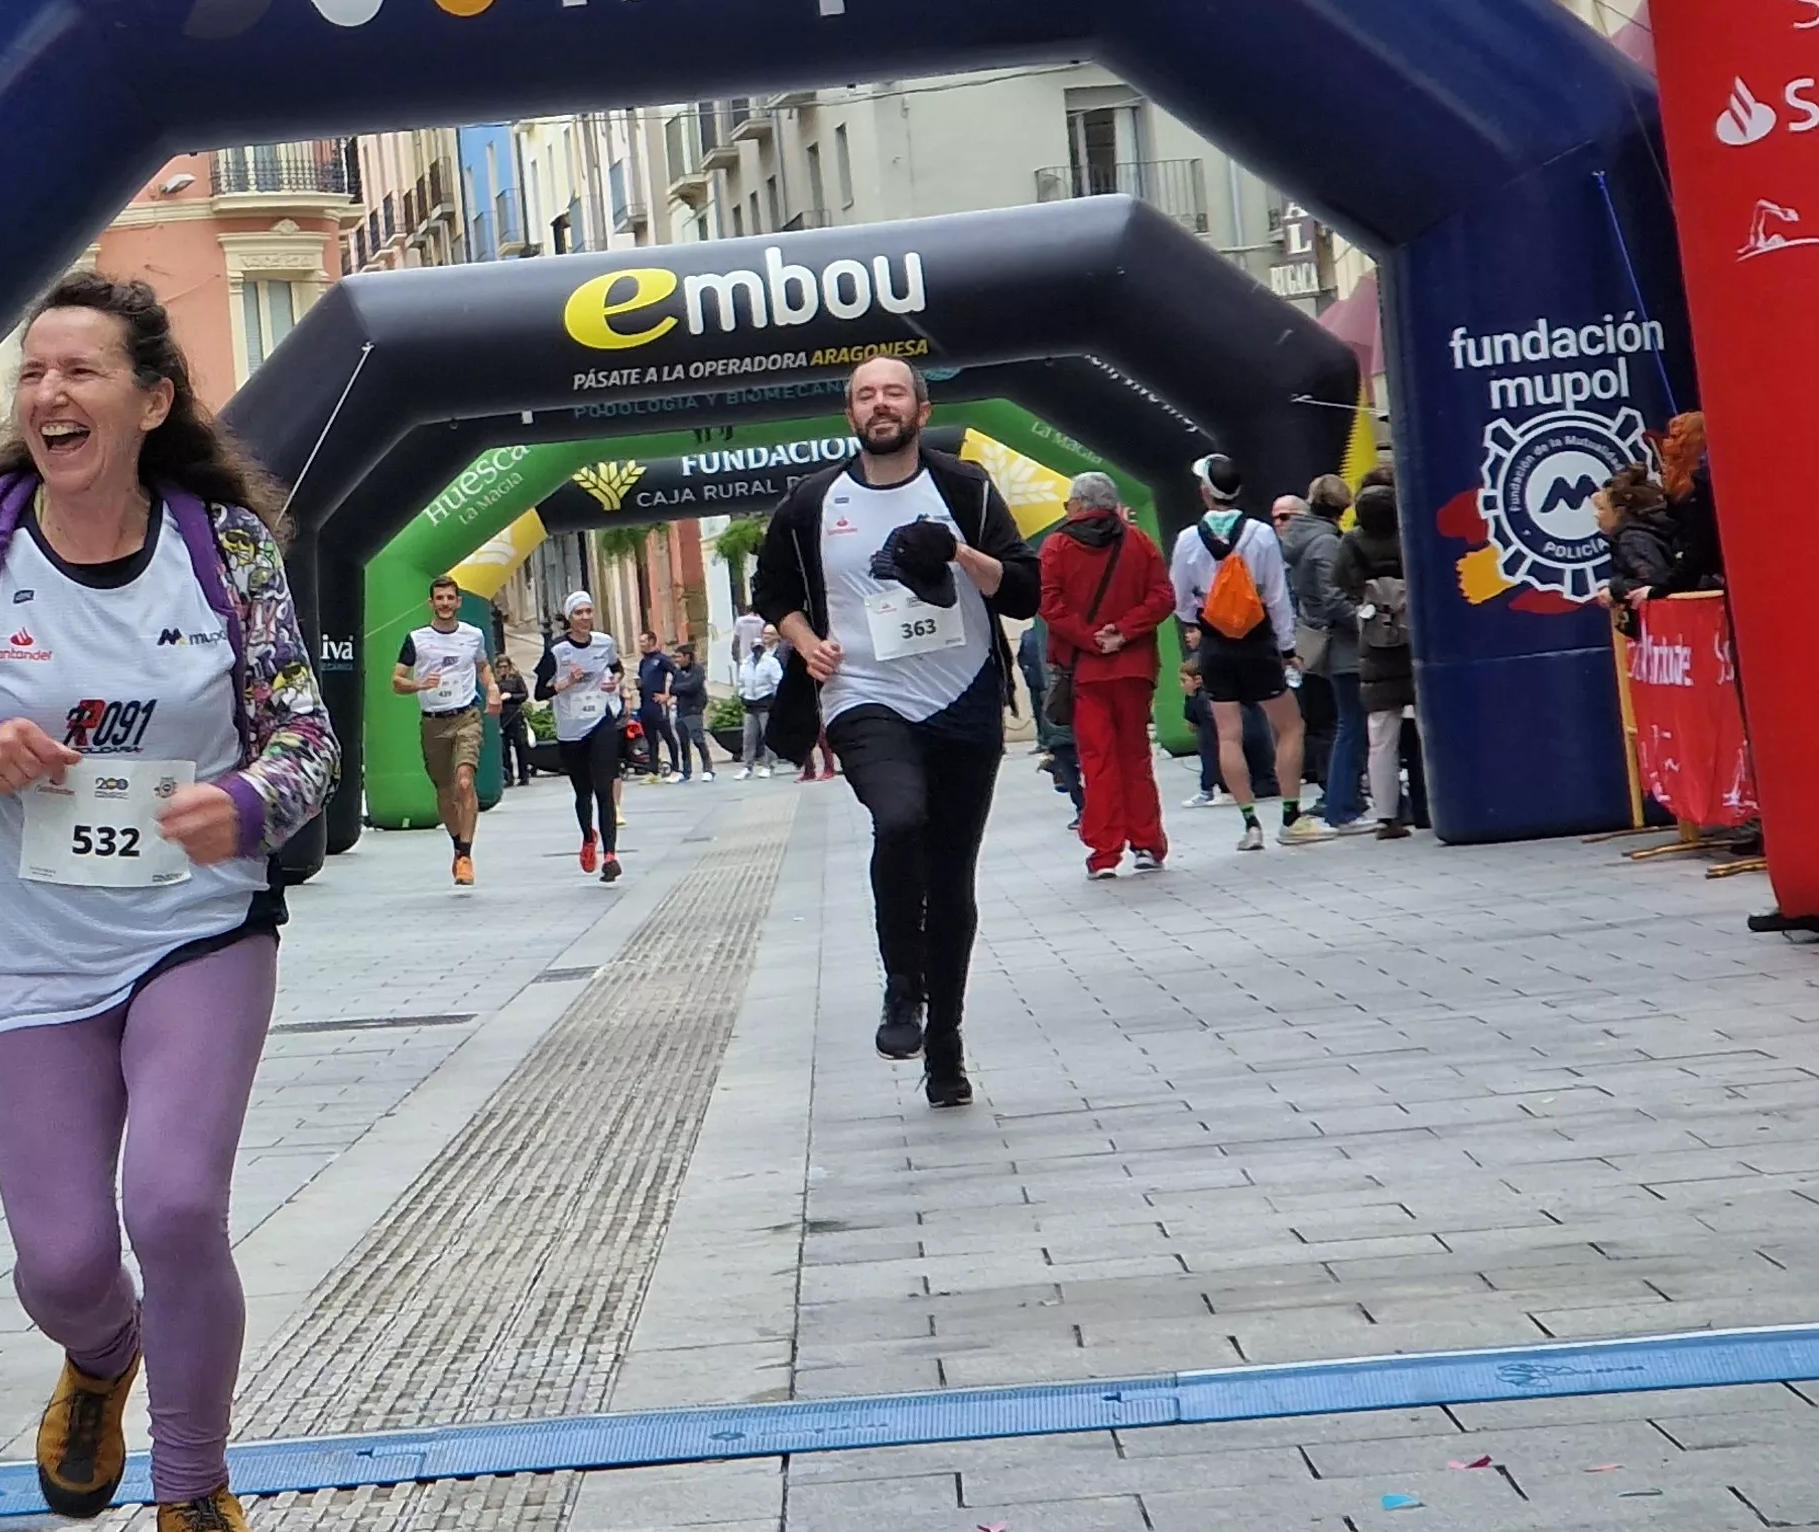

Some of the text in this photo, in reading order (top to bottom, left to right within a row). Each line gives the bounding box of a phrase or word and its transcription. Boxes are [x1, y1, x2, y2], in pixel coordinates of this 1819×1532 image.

[564, 246, 926, 349] embou
[1449, 310, 1664, 369] fundación
[573, 338, 929, 390] PÁSATE A LA OPERADORA ARAGONESA
[1489, 356, 1630, 411] mupol
[636, 485, 698, 509] CAJA
[704, 476, 779, 502] RURAL
[1543, 537, 1611, 559] POLICÍA
[900, 618, 937, 640] 363
[71, 824, 141, 858] 532
